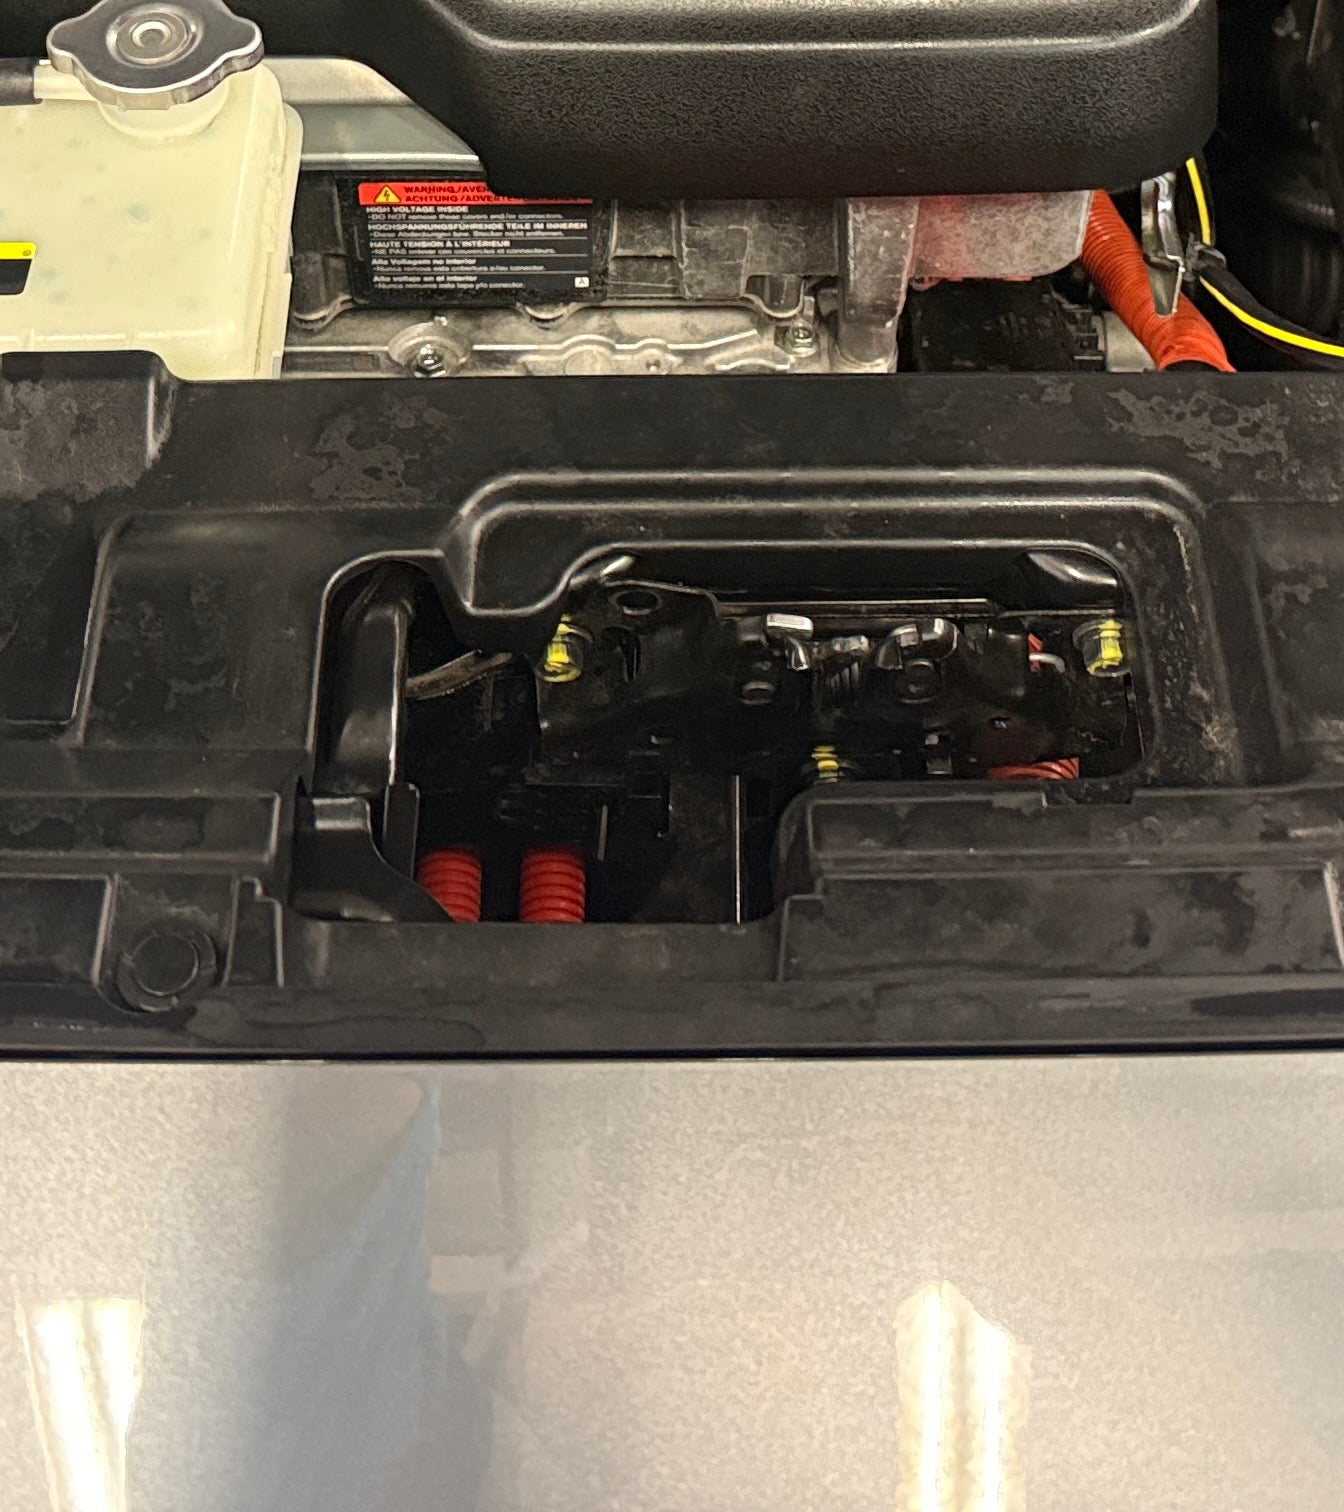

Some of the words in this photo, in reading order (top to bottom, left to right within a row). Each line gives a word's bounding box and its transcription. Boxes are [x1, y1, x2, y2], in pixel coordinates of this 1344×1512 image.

[403, 186, 456, 194] WARNING
[369, 240, 401, 248] HAUTE
[403, 240, 445, 248] TENSION
